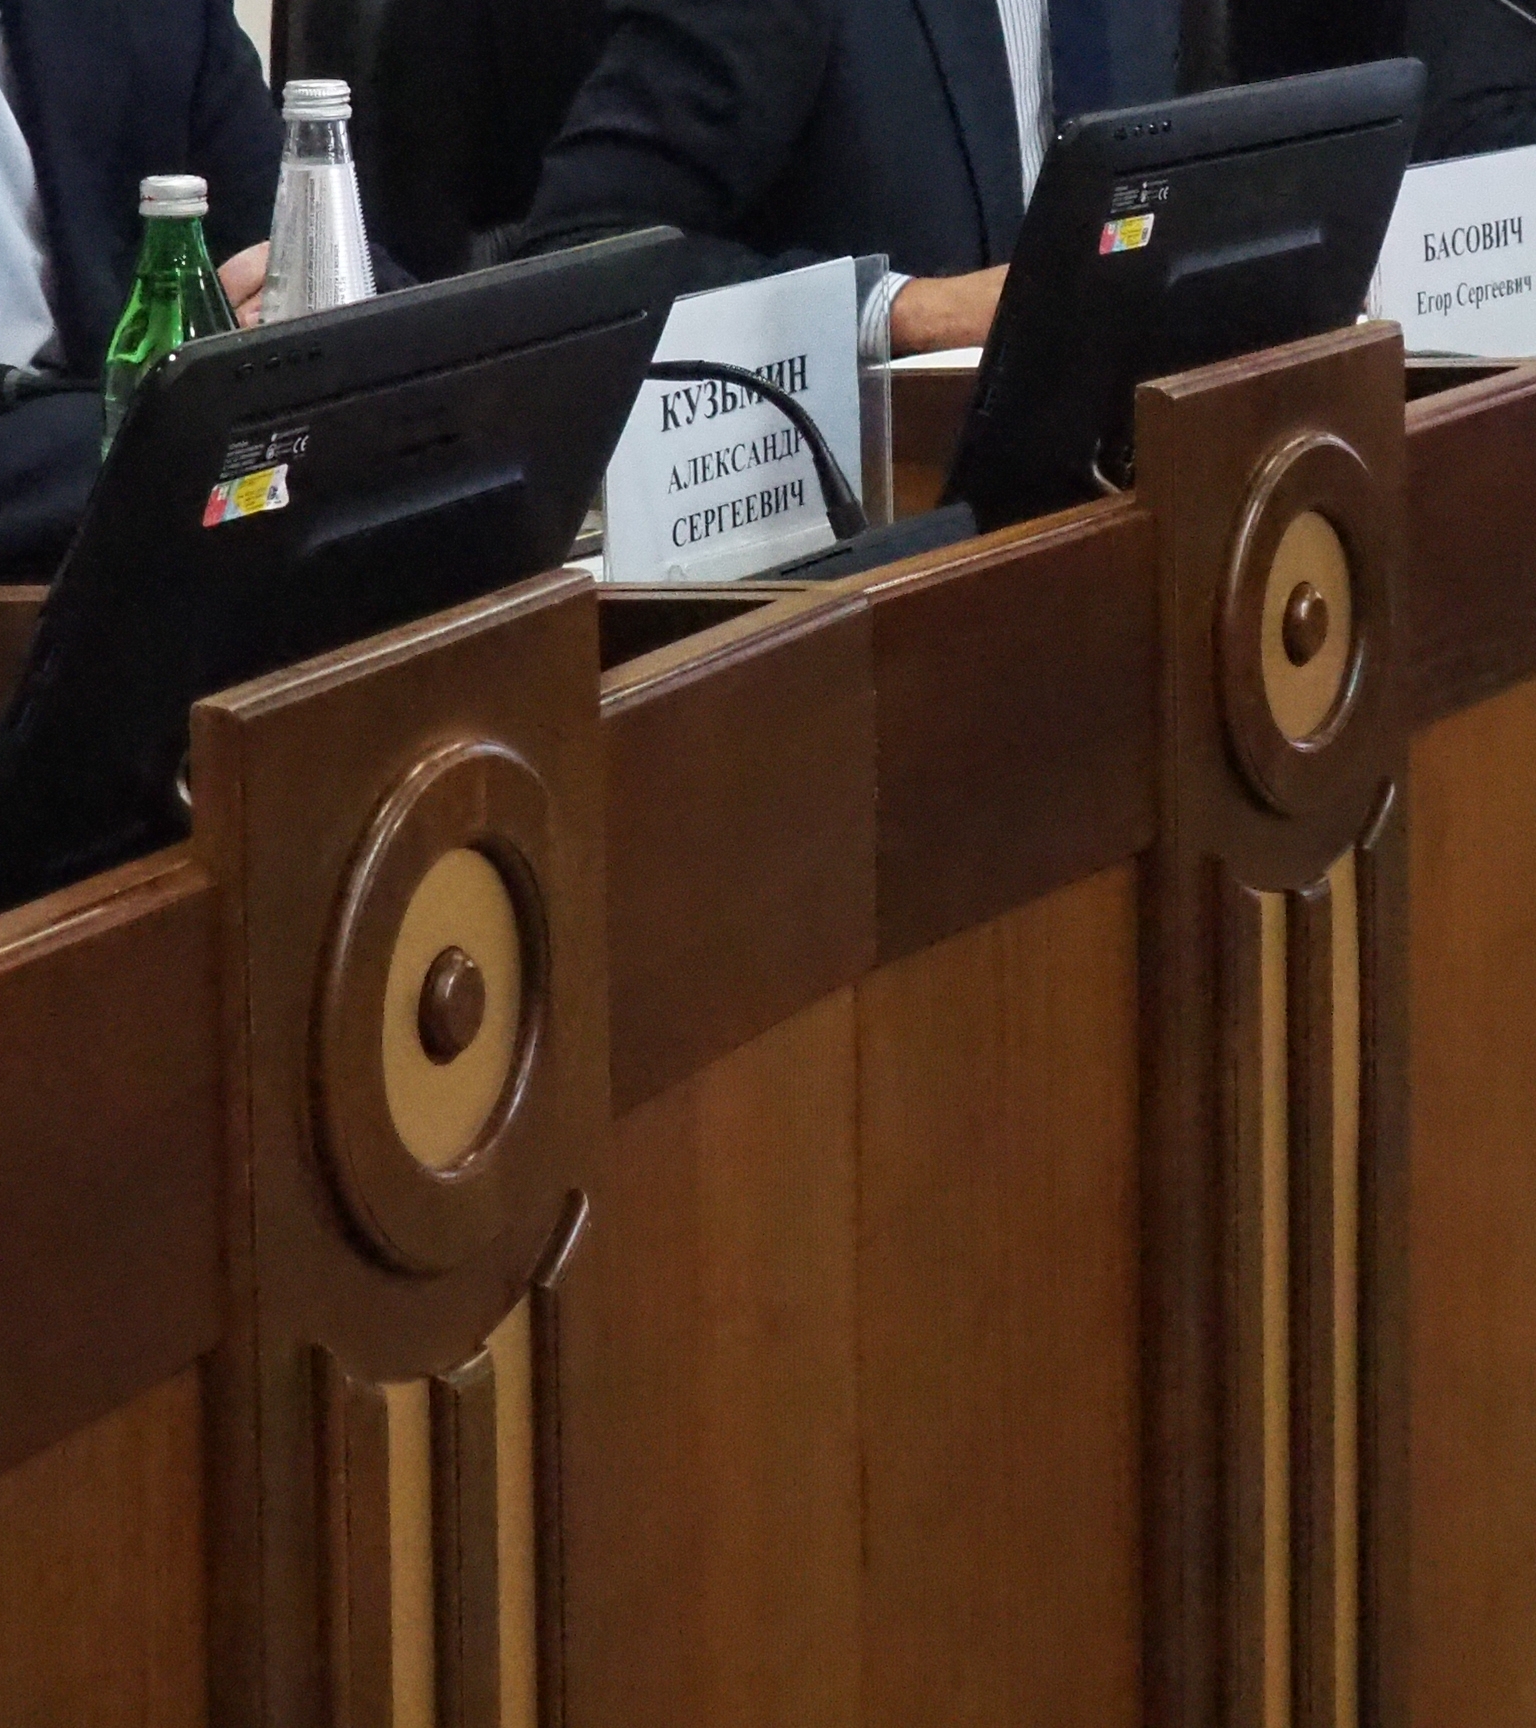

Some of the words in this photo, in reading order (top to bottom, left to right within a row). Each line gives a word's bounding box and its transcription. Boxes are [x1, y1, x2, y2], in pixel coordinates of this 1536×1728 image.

[1423, 215, 1523, 263] БАСОВИЧ
[1416, 290, 1453, 317] Егор
[1456, 274, 1532, 310] Сергеевич
[671, 478, 806, 548] СЕРГЕЕВИЧ
